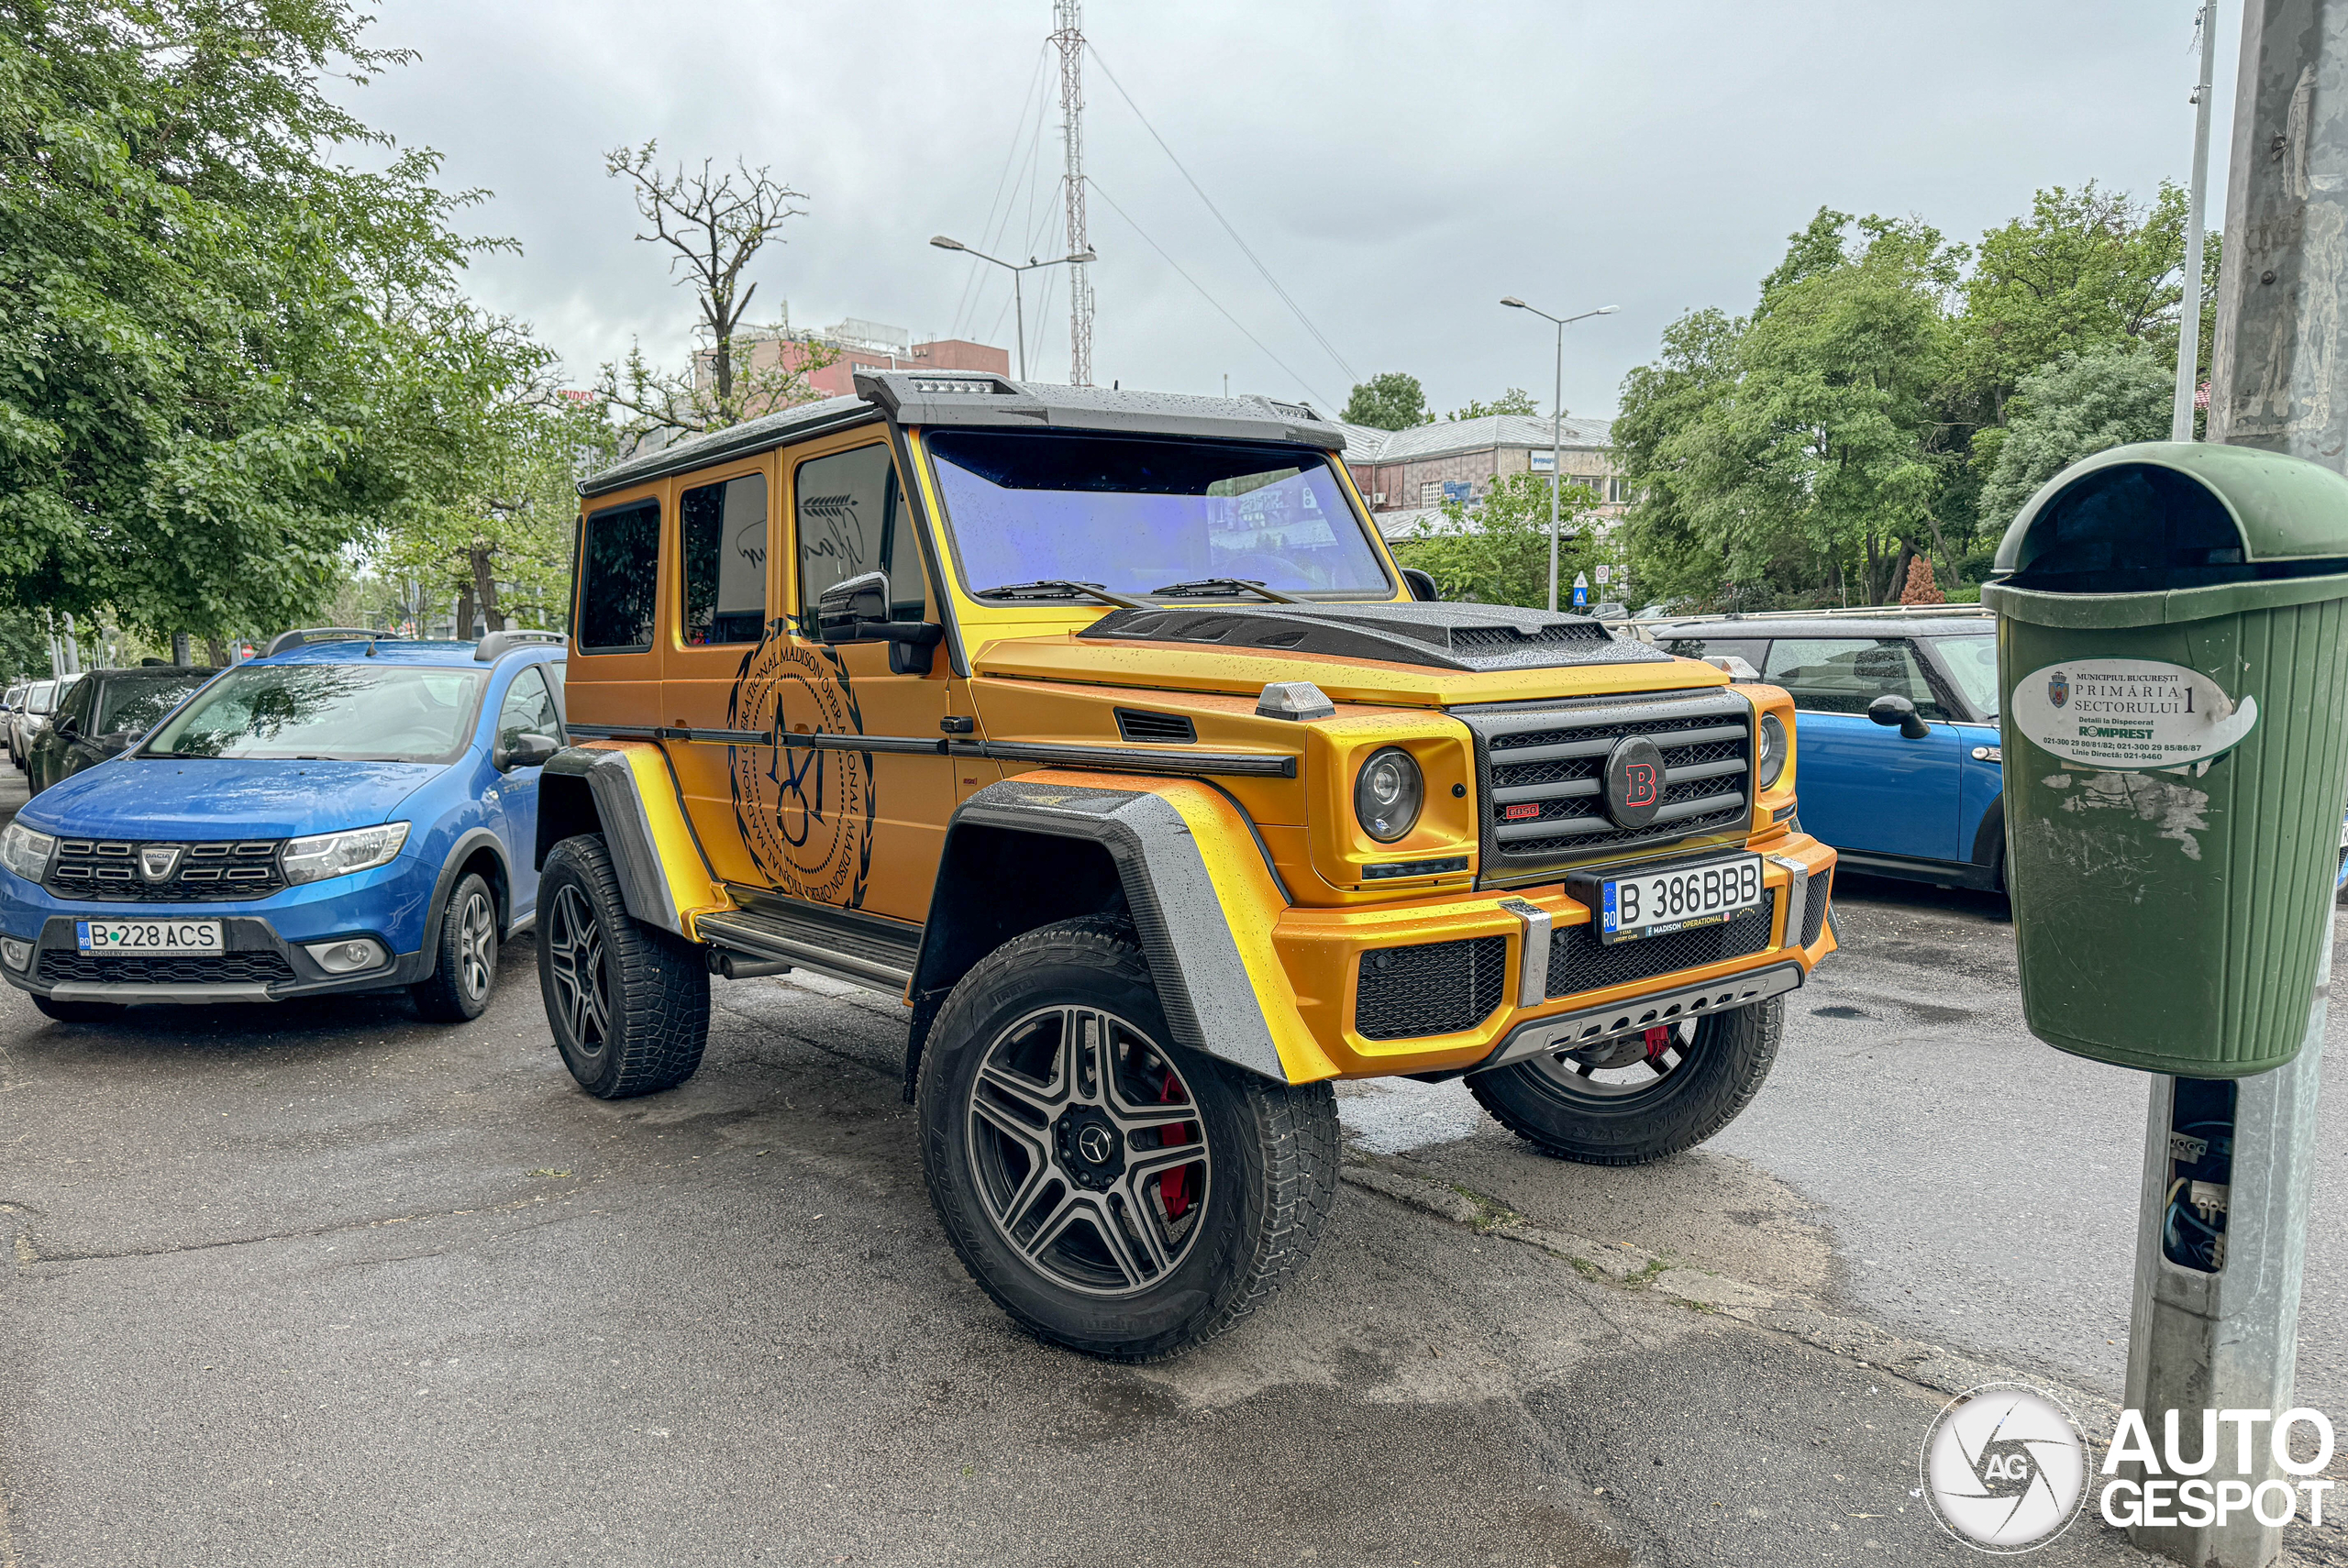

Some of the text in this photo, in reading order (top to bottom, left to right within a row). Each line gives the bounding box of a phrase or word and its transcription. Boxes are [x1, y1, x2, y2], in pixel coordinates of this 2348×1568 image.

[781, 646, 825, 681] MADISON
[2077, 673, 2126, 682] MUNICIPIUL
[2076, 684, 2178, 698] PRIMĂRIA
[2075, 686, 2196, 714] SECTORULUI 1
[2078, 716, 2102, 724] Detalii
[2111, 718, 2154, 726] Dispecerat
[2043, 737, 2070, 746] 021-300
[2071, 739, 2080, 747] 29
[2117, 743, 2150, 751] 021-300
[2152, 744, 2163, 752] 29
[2071, 748, 2089, 756] Linie
[2123, 752, 2163, 760] 021-9460
[1626, 764, 1657, 807] B
[1621, 865, 1757, 924] B 386BBB
[1604, 911, 1616, 928] RO
[1653, 922, 1682, 934] MADISON
[1682, 914, 1722, 929] OPERATIONAL
[80, 937, 89, 946] RO
[92, 924, 215, 946] B 228 ACS
